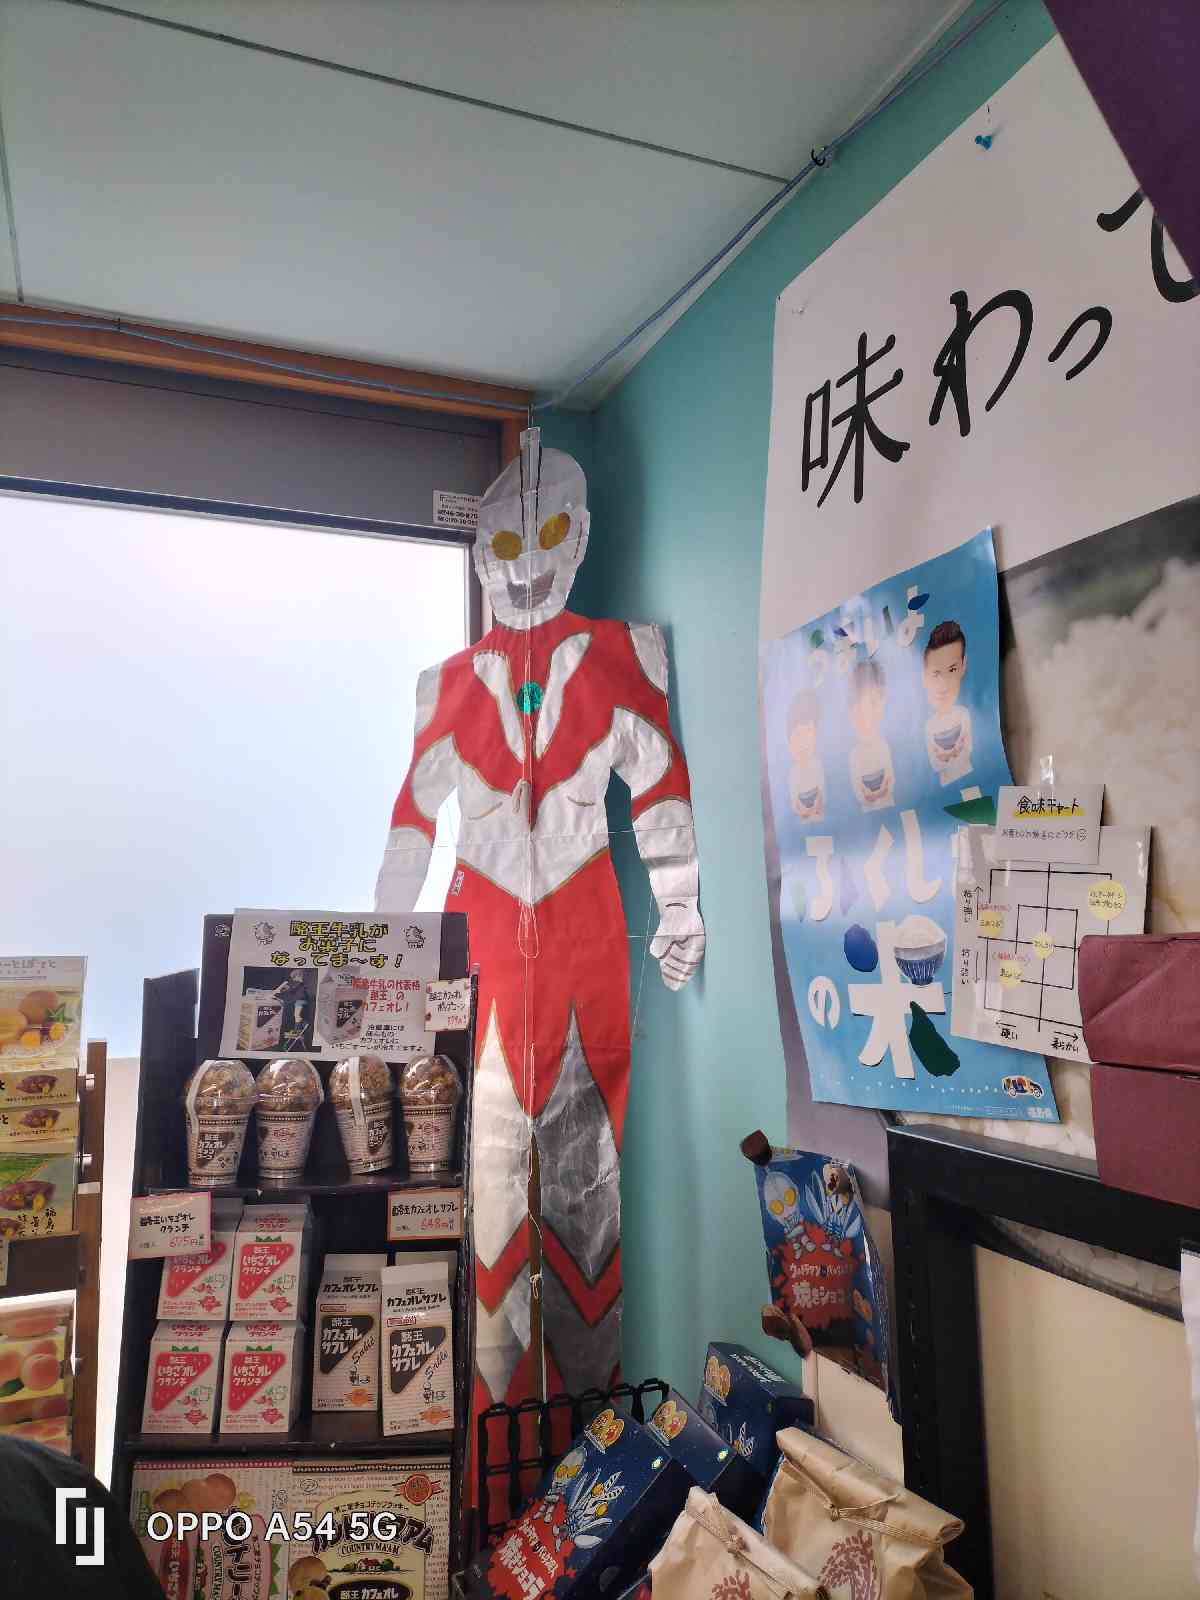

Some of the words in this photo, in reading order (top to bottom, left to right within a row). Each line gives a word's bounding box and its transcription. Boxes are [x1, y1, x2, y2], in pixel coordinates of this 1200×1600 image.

[1016, 794, 1080, 815] 食味チャート
[288, 919, 390, 939] 酪王牛乳が
[298, 938, 378, 953] お菓子に
[159, 1224, 191, 1233] クランチ
[241, 1255, 281, 1267] いちごオレ
[241, 1266, 272, 1275] クランチ
[322, 1283, 379, 1293] カフェオレサブレ
[386, 1293, 448, 1307] カフェオレサブレ
[322, 1327, 363, 1342] カフェオレ
[321, 1341, 349, 1354] サブレ
[391, 1341, 436, 1358] カフェオレ
[391, 1357, 422, 1372] サブレ
[157, 1365, 198, 1377] いちごオレ
[233, 1365, 272, 1377] いちごオレ
[155, 1377, 189, 1388] クランチ
[232, 1377, 262, 1388] クランチ
[341, 1543, 375, 1555] COUNTRY
[360, 1586, 399, 1600] カフェオレ
